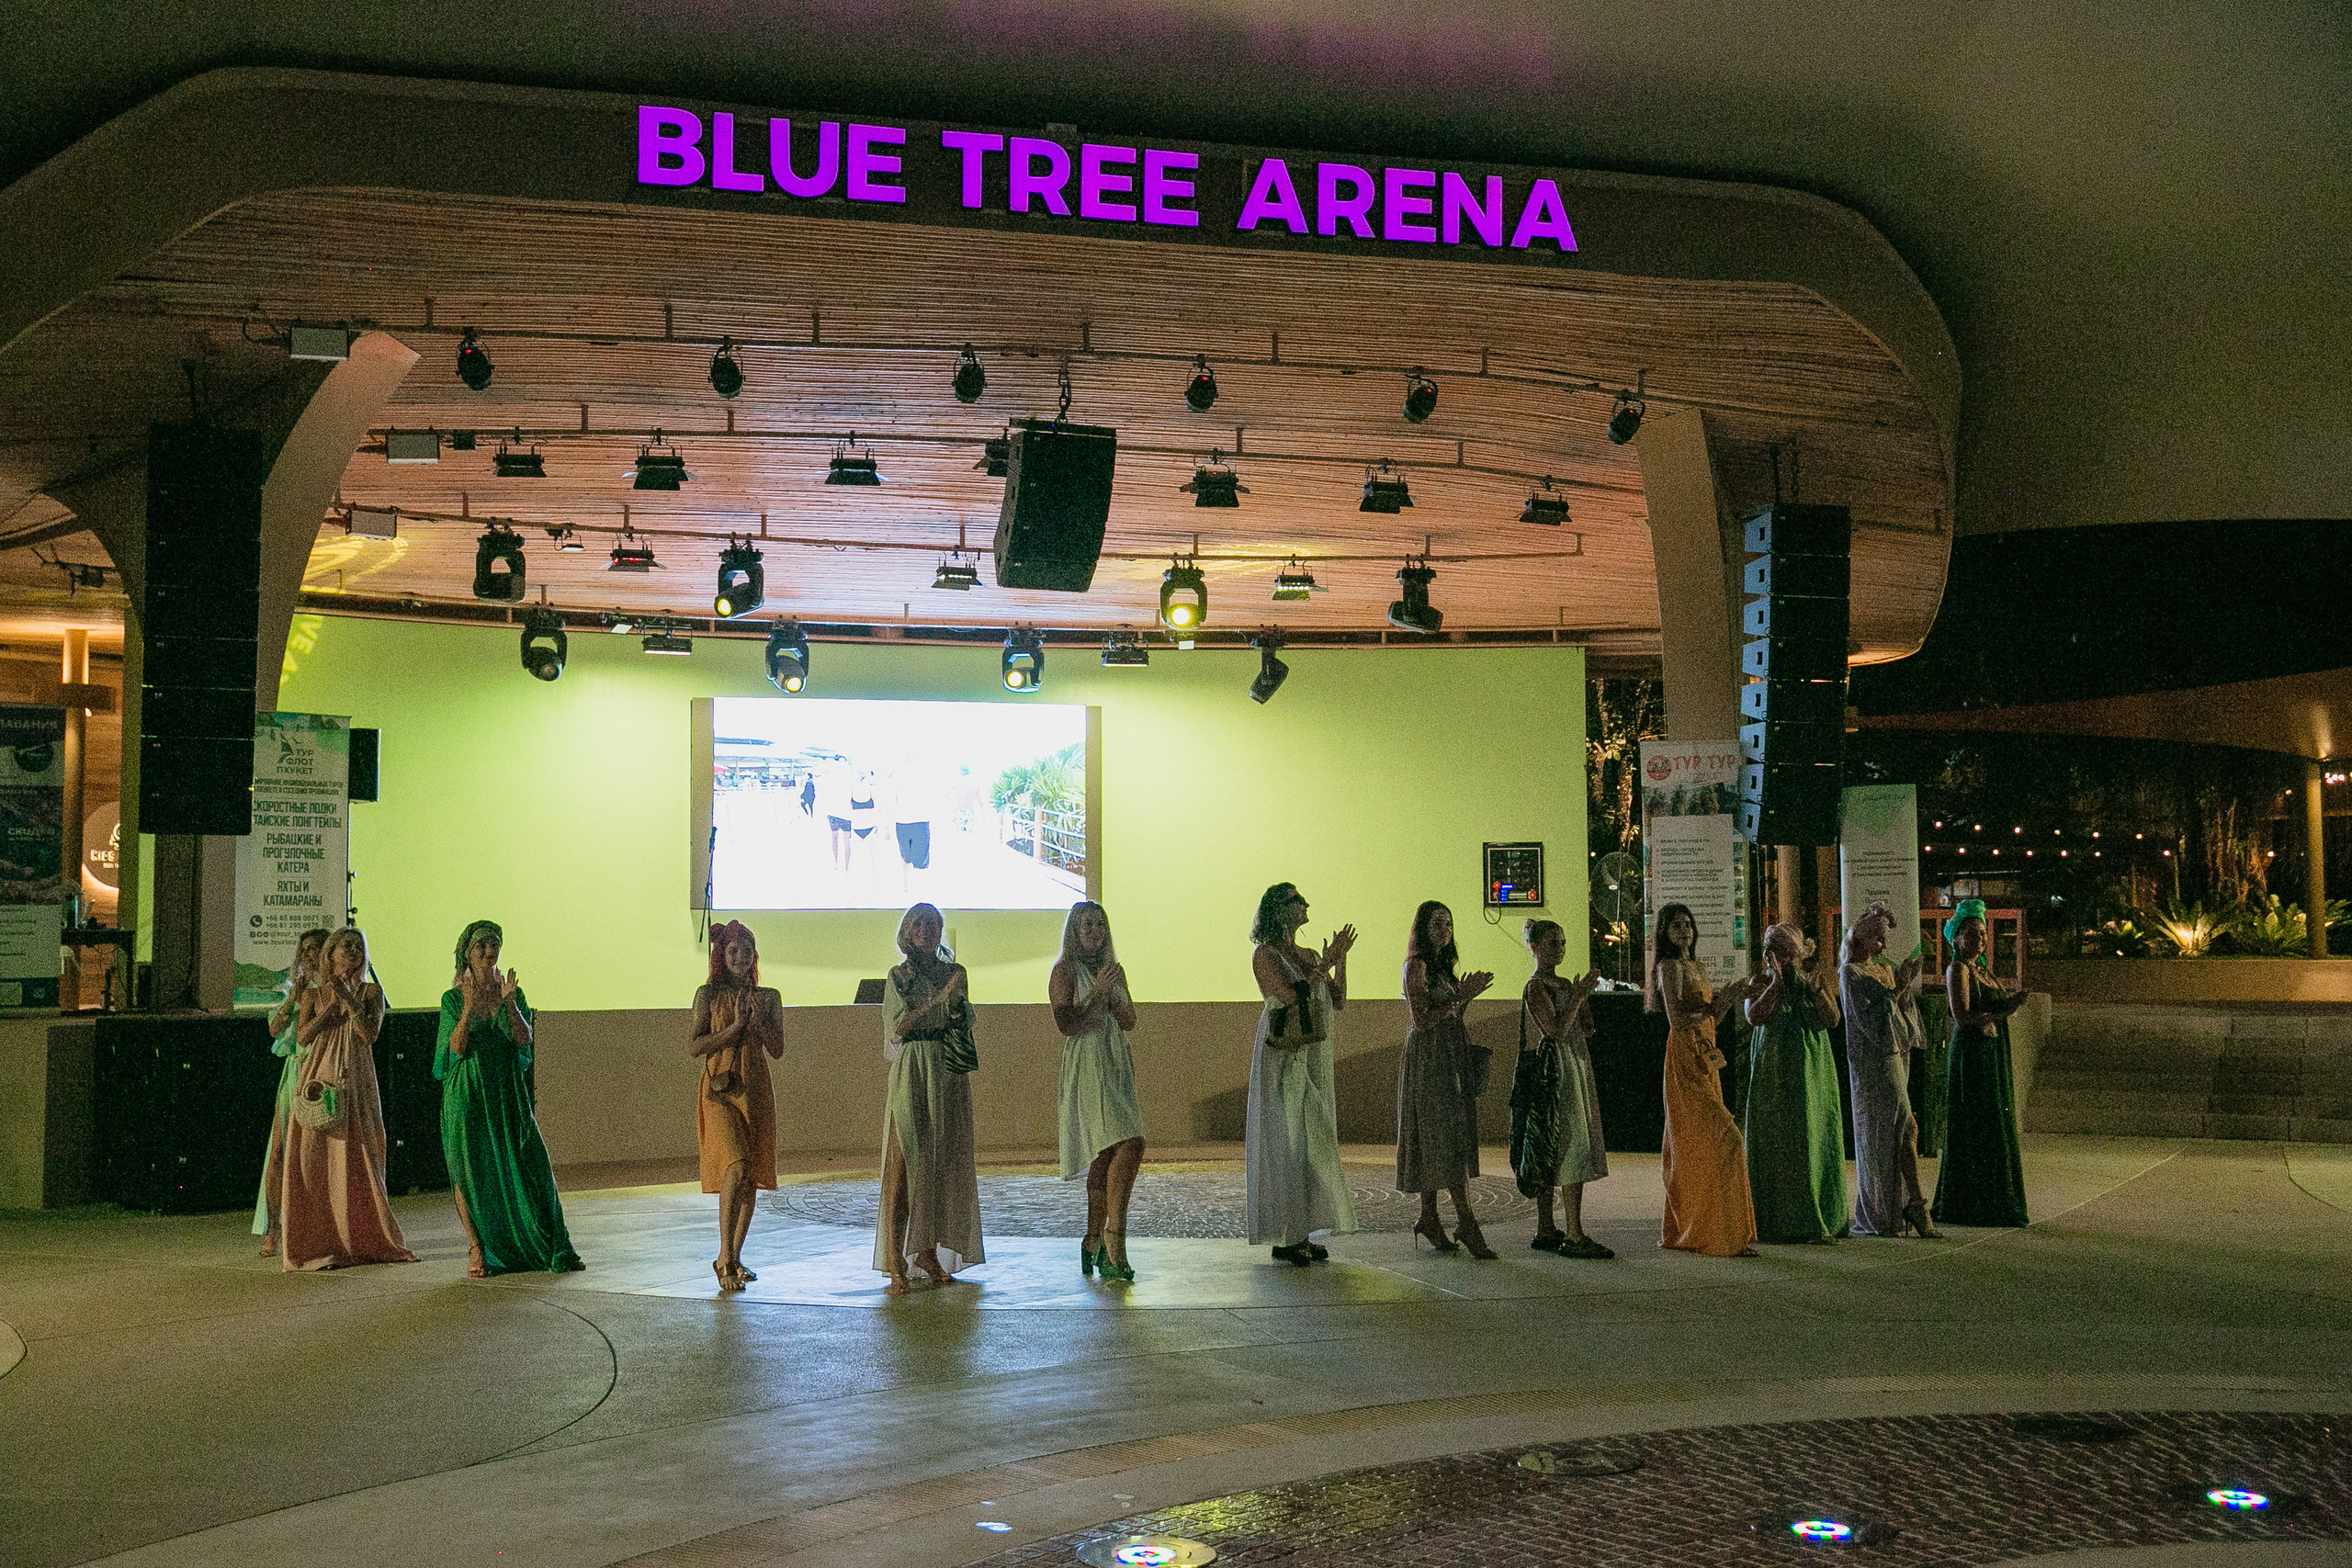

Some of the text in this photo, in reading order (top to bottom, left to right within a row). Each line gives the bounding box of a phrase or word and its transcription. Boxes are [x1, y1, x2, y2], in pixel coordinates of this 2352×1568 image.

[638, 106, 1577, 251] BLUE TREE ARENA
[295, 749, 314, 757] ТУР
[286, 758, 314, 766] ФЛОТ
[277, 766, 314, 774] ПХУКЕТ
[253, 801, 336, 815] СКОРОСТНЫЕ ЛОДКИ
[253, 813, 342, 829] ТАЙСКИЕ ЛОНГТЕЙЛЫ
[266, 832, 322, 845] РЫБАЦКИЕ И
[263, 847, 325, 860] ПРОГУЛОЧНЫЕ
[277, 862, 309, 873] КАТЕРА
[277, 880, 309, 892] ЯХТЫ И
[263, 895, 322, 906] КАТАМАРАНЫ
